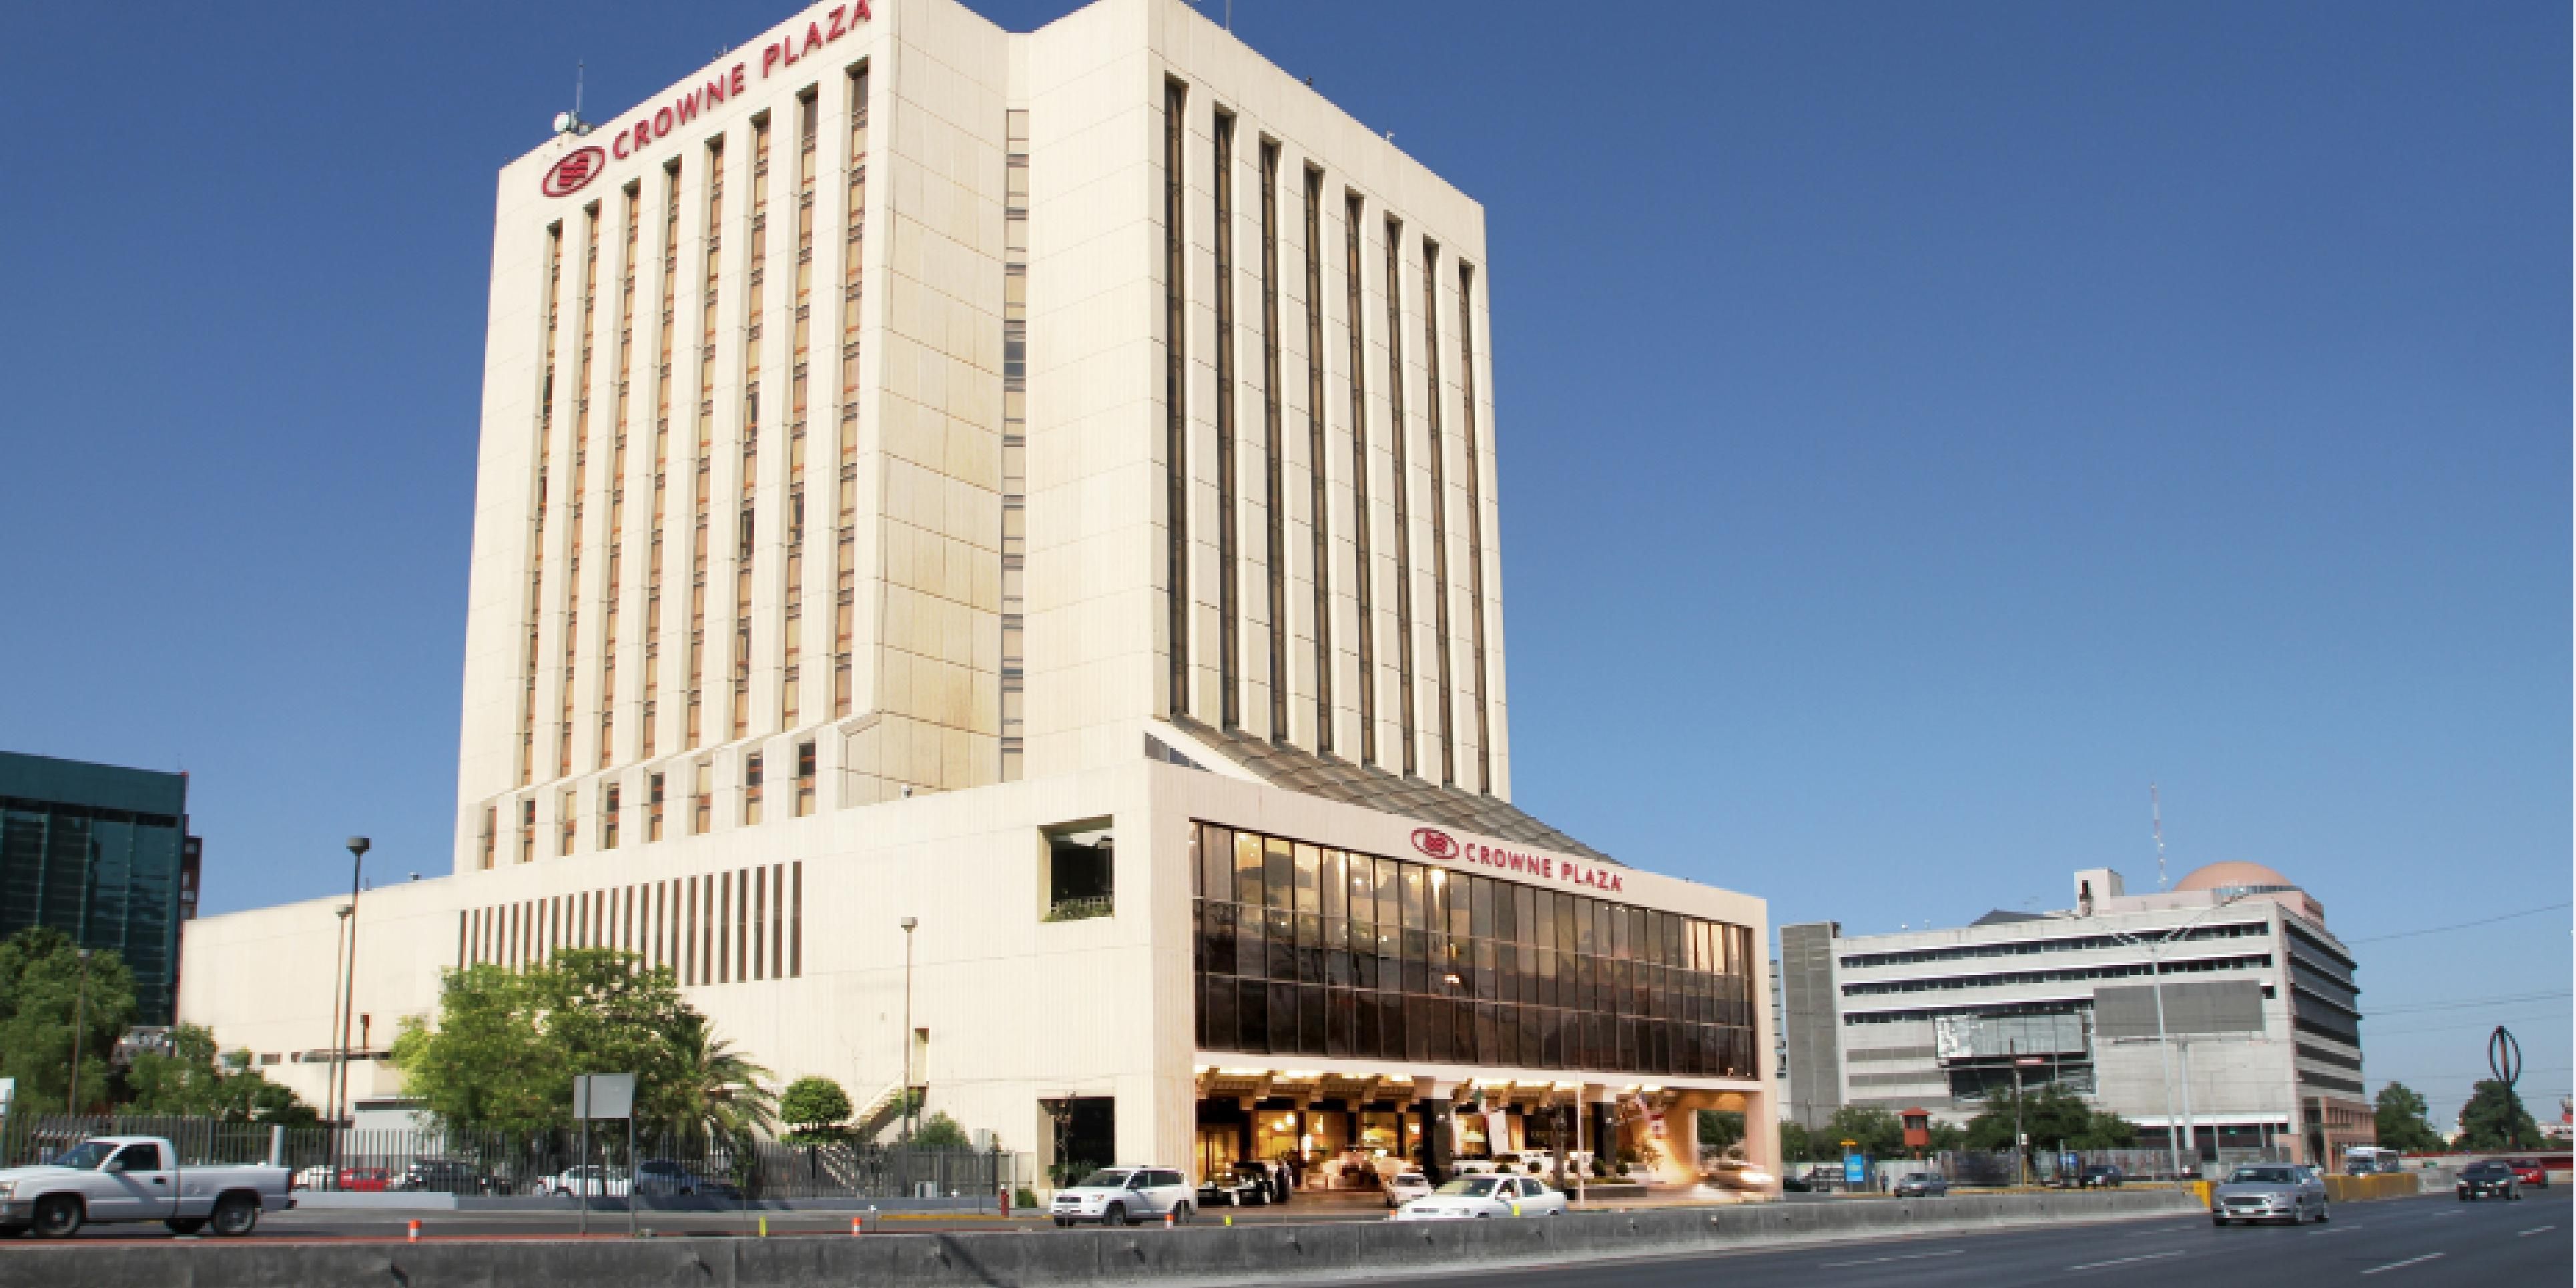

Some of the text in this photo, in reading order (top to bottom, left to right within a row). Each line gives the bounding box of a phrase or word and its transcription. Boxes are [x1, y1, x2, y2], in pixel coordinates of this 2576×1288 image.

[613, 0, 872, 160] CROWNE PLAZA
[1464, 843, 1623, 893] CROWNE PLAZA
